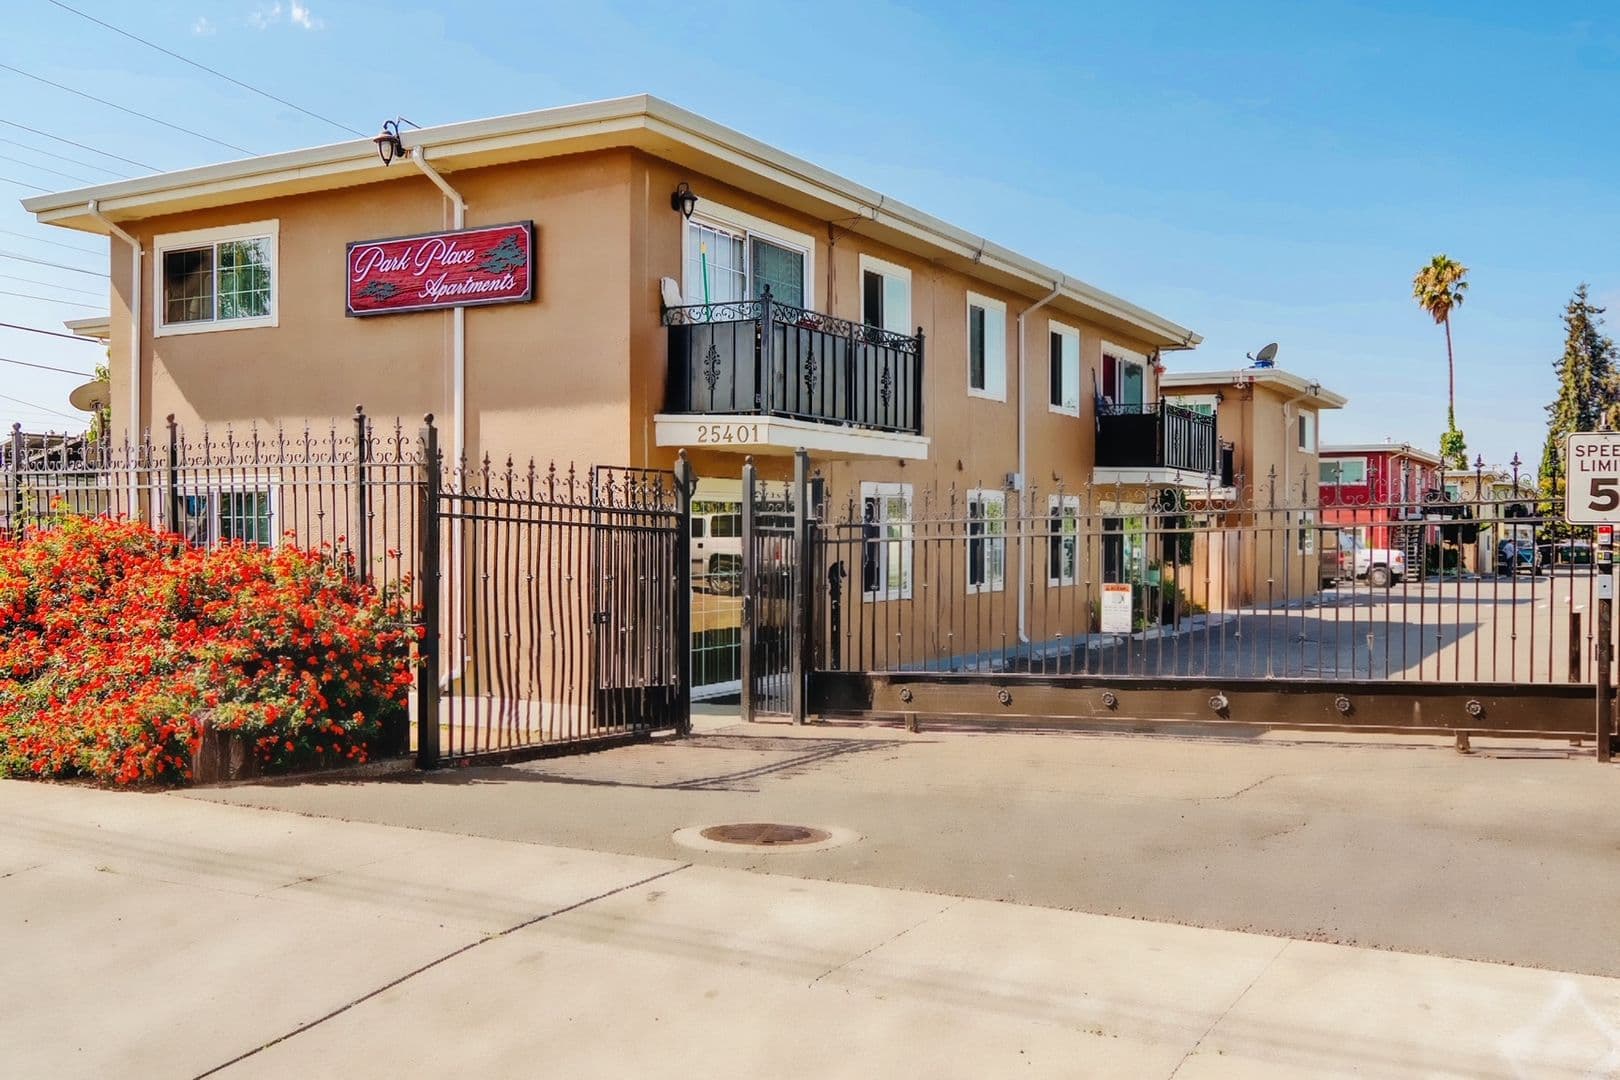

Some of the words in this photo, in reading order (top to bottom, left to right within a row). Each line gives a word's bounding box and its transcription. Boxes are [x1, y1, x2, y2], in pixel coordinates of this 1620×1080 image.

[353, 246, 411, 283] Park
[413, 238, 475, 276] Place
[418, 272, 517, 302] Apartments
[697, 424, 758, 443] 25401
[1575, 444, 1620, 457] SPEE
[1580, 460, 1618, 472] LIMI
[1588, 478, 1620, 512] 5
